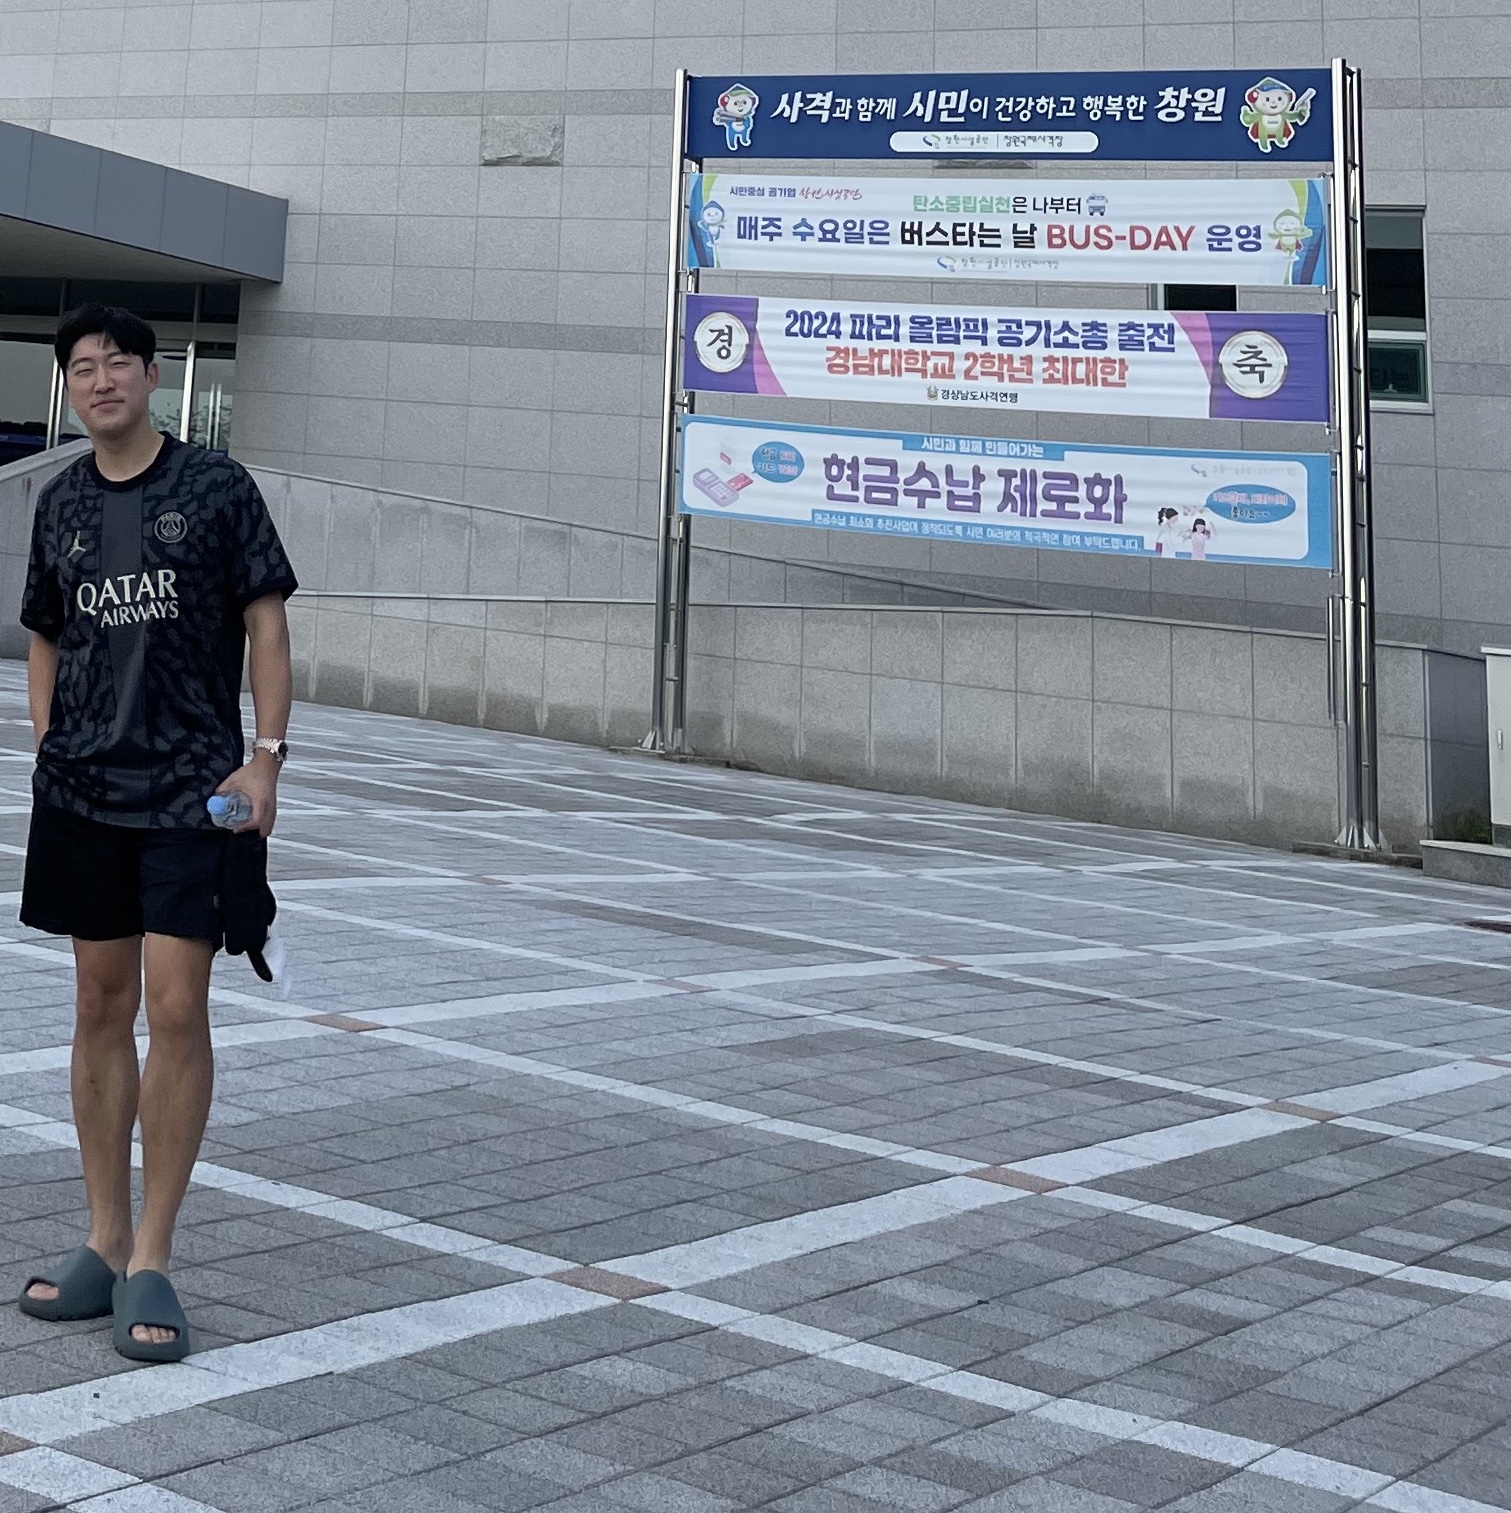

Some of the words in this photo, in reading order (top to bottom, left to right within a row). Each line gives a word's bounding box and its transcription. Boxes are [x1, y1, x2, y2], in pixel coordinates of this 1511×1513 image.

[770, 90, 852, 123] 사격과
[856, 97, 896, 122] 함께
[902, 89, 988, 123] 시민이
[994, 95, 1076, 120] 건강하고
[1082, 94, 1147, 122] 행복한
[1153, 86, 1226, 123] 창원
[729, 186, 765, 197] 시민중심
[768, 187, 796, 198] 공기업
[912, 195, 1028, 215] 탄소중립실천은
[1033, 195, 1082, 215] 나부터
[737, 216, 782, 242] 매주
[792, 217, 890, 245] 수요일은
[900, 220, 1002, 248] 버스타는
[1012, 223, 1038, 250] 날
[1046, 224, 1196, 252] BUS-DAY
[1206, 224, 1262, 253] 운영
[707, 324, 733, 360] 경
[785, 309, 841, 339] 2024
[849, 313, 900, 343] 파리
[909, 315, 988, 346] 올림픽
[997, 318, 1108, 351] 공기소총
[1117, 322, 1175, 353] 출전
[826, 346, 956, 380] 경남대학교
[963, 351, 1033, 384] 2학년
[1042, 355, 1128, 388] 최대한
[1232, 344, 1272, 385] 축
[921, 437, 955, 452] 시민과
[959, 439, 982, 454] 함께
[985, 441, 1044, 458] 만들어가는
[823, 453, 986, 513] 현금수납
[997, 468, 1128, 525] 제로화
[76, 569, 179, 616] QATAR
[100, 600, 179, 629] AIRWAYS
